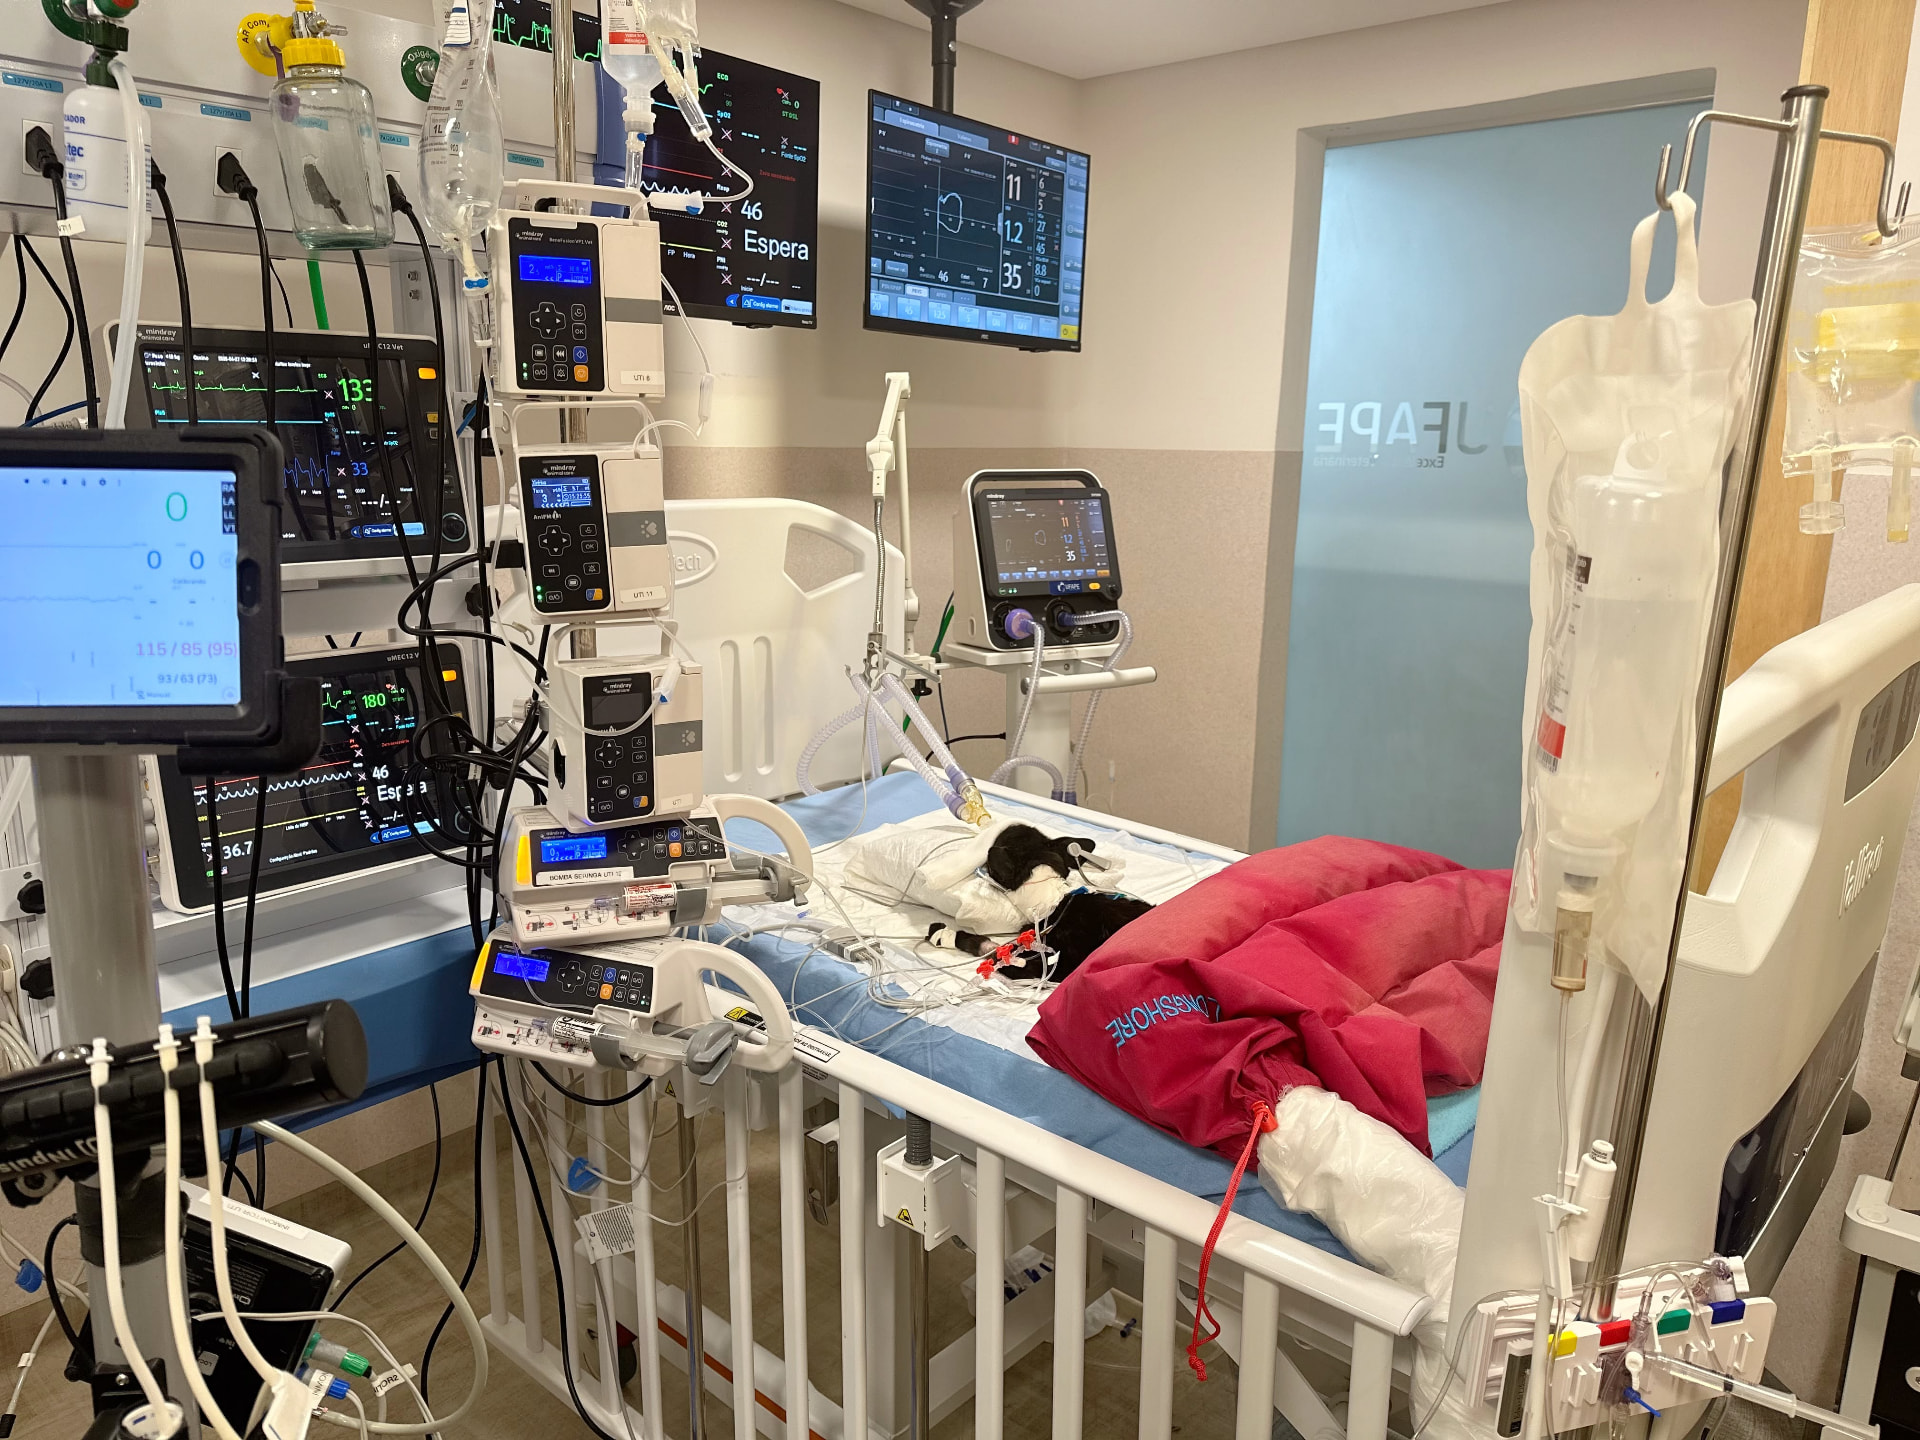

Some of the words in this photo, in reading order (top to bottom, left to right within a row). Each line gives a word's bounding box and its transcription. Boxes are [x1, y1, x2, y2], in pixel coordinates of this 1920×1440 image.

[242, 28, 250, 44] AR
[794, 100, 800, 109] 0
[433, 124, 443, 134] 1L
[1006, 174, 1021, 201] 11
[1038, 178, 1045, 190] 6
[740, 200, 763, 221] 46
[1038, 198, 1043, 211] 5
[1004, 220, 1023, 244] 1.2
[1036, 220, 1047, 233] 27
[744, 229, 809, 261] Espera
[1036, 242, 1046, 255] 45
[938, 270, 949, 283] 46
[1002, 262, 1022, 290] 35
[1034, 264, 1047, 277] 8.8
[983, 278, 989, 289] 7
[1034, 284, 1040, 297] 0
[664, 304, 676, 312] AOC
[146, 328, 177, 337] mindray
[352, 462, 369, 476] 33
[550, 464, 577, 472] mindray
[222, 484, 236, 493] RA
[223, 496, 236, 506] LA
[542, 494, 548, 503] 3
[166, 492, 188, 522] 0
[224, 510, 236, 520] LL
[1061, 516, 1070, 528] 11
[147, 550, 162, 570] 0
[190, 550, 205, 570] 0
[1066, 550, 1077, 562] 35
[136, 642, 167, 657] 115
[182, 642, 203, 657] 85
[207, 642, 238, 659] (95)
[158, 674, 172, 685] 93
[180, 674, 195, 685] 63
[197, 674, 218, 686] (73)
[362, 692, 386, 709] 180
[372, 764, 390, 780] 46
[222, 840, 253, 860] 36.7
